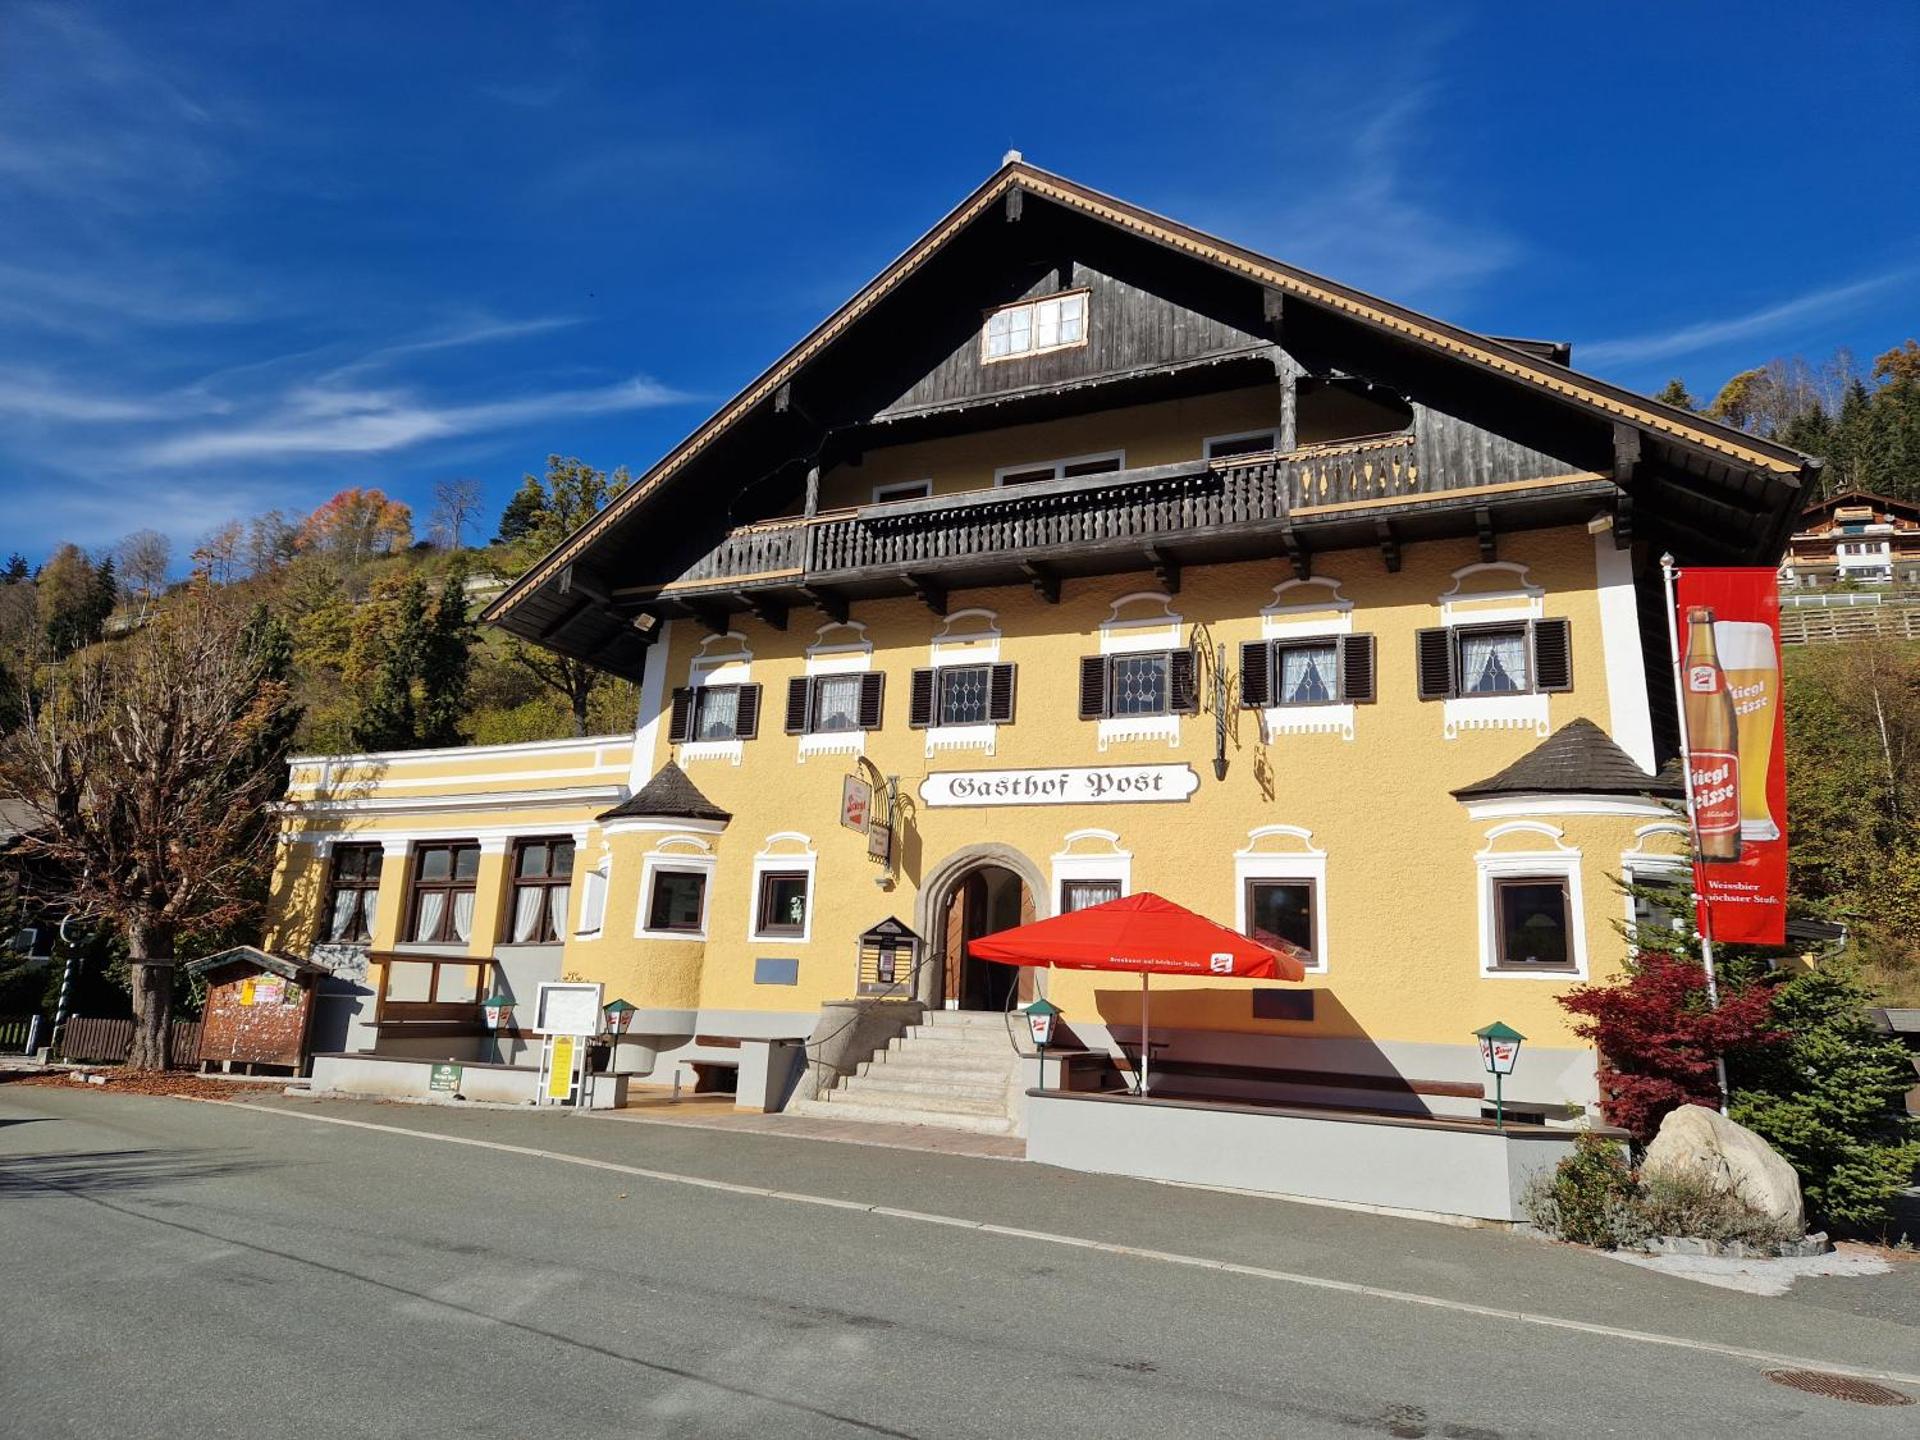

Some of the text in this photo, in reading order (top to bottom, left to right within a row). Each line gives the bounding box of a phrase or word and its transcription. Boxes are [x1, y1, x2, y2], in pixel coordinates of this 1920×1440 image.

[1735, 696, 1769, 716] eisse
[948, 771, 1164, 798] Gasthof Post
[1690, 763, 1729, 786] tiegl
[1695, 783, 1734, 810] eisse
[1708, 880, 1760, 891] Weissbier
